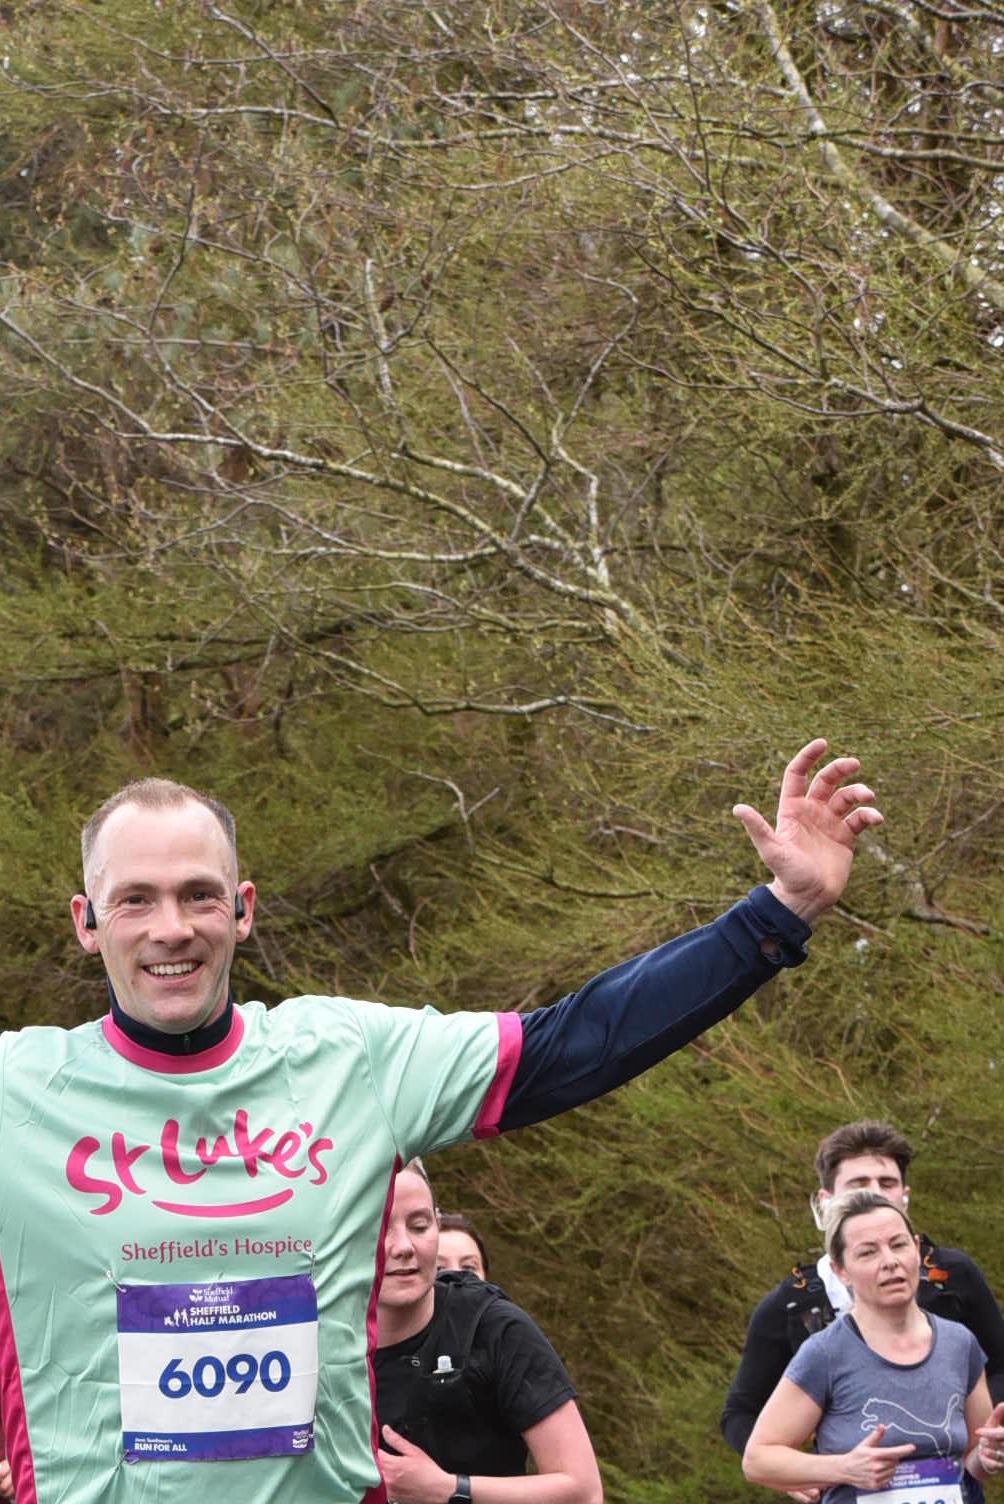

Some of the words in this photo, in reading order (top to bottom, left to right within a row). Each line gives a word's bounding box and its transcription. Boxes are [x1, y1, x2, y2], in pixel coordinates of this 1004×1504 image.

[66, 1132, 150, 1215] St
[160, 1108, 333, 1185] Luke's
[121, 1239, 228, 1264] Sheffield's
[235, 1235, 312, 1258] Hospice
[189, 1305, 241, 1316] SHEFFIELD
[189, 1316, 216, 1327] HALF
[218, 1311, 277, 1325] MARATHON
[158, 1350, 291, 1399] 6090
[134, 1442, 152, 1451] RUN
[154, 1443, 170, 1452] FOR
[171, 1443, 188, 1452] ALL
